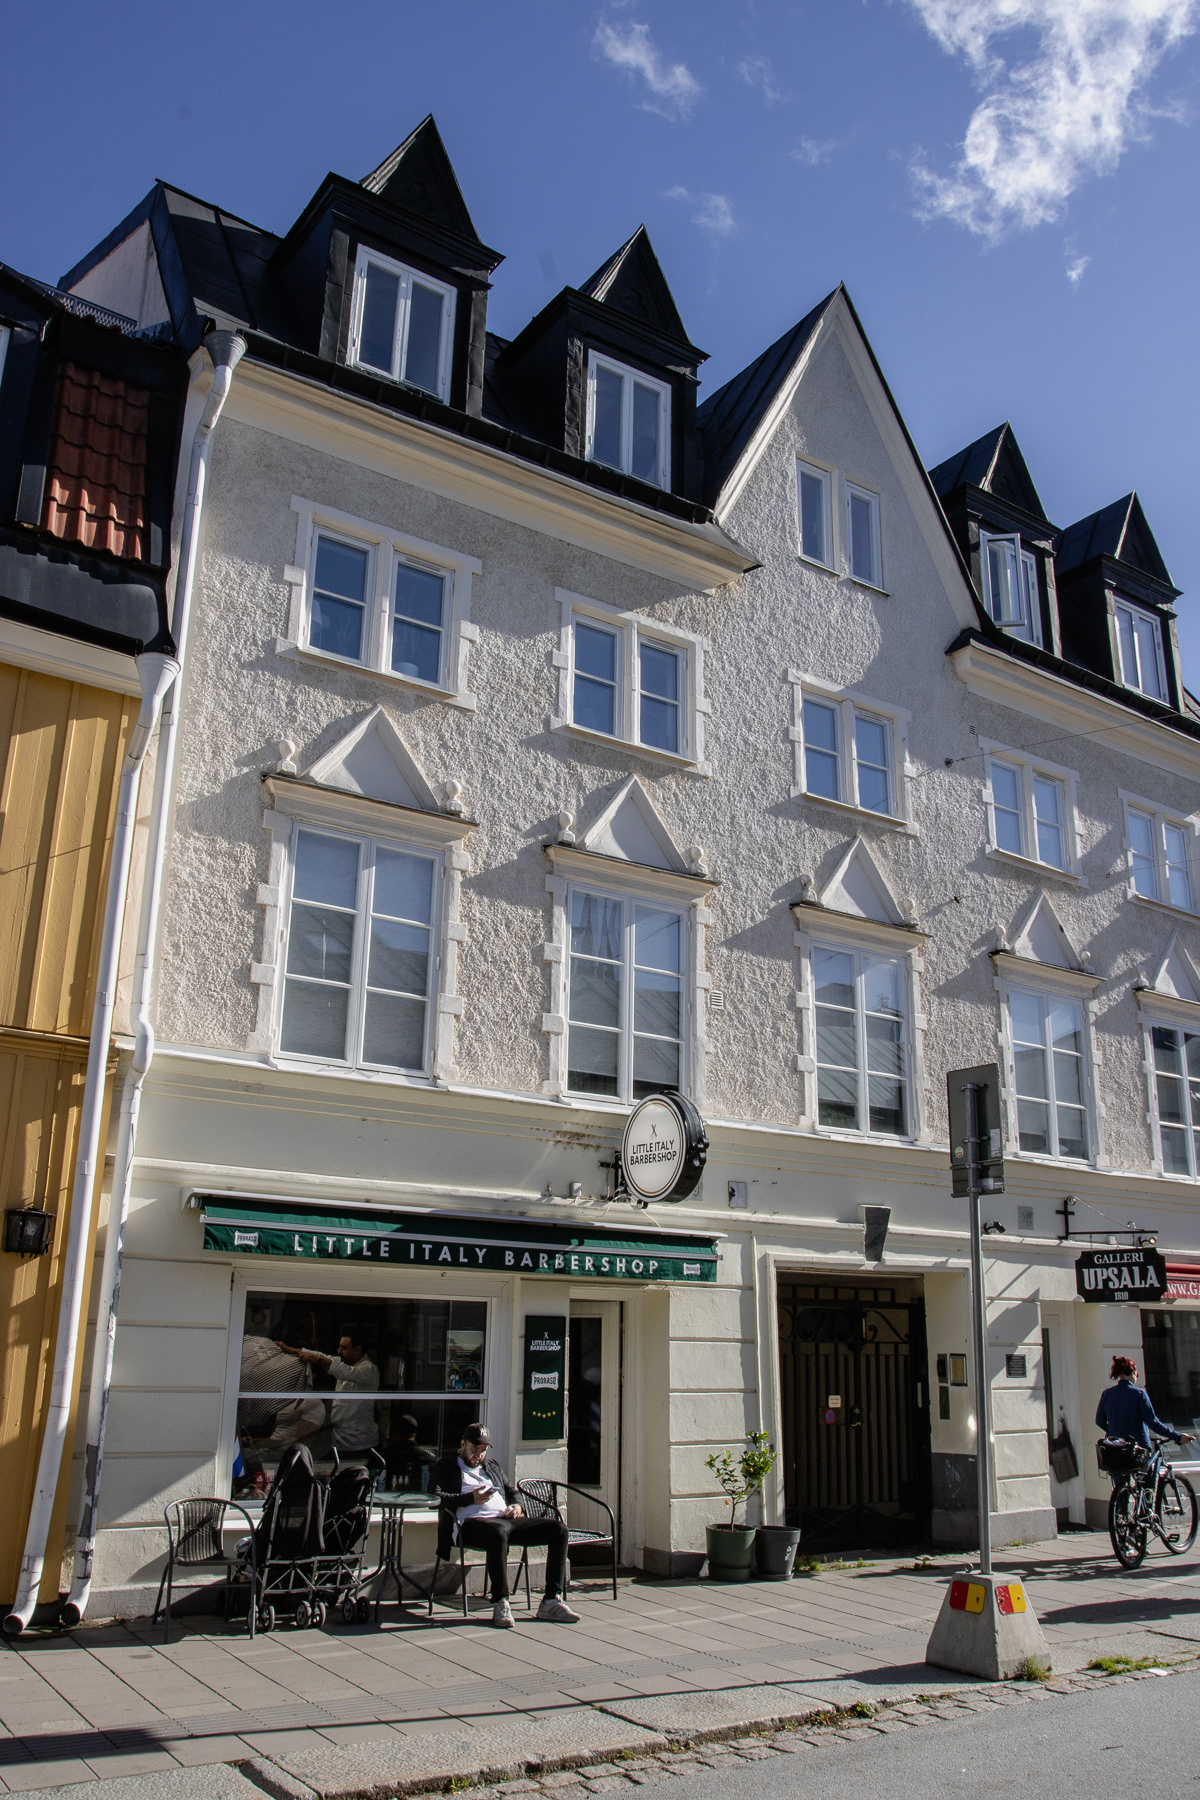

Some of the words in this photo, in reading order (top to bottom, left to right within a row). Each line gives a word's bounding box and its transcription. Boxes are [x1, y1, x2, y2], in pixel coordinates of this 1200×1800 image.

[632, 1142, 653, 1155] LITTLE
[655, 1139, 675, 1152] ITALY
[630, 1150, 677, 1166] BARBERSHOP
[294, 1234, 389, 1257] LITTLE
[409, 1243, 487, 1264] ITALY
[504, 1250, 660, 1274] BARBERSHOP
[1094, 1252, 1144, 1264] GALLERI
[1082, 1265, 1161, 1290] UPSALA
[1114, 1291, 1129, 1301] 1810
[1167, 1282, 1200, 1296] WW.G
[533, 1376, 557, 1385] PRORASO
